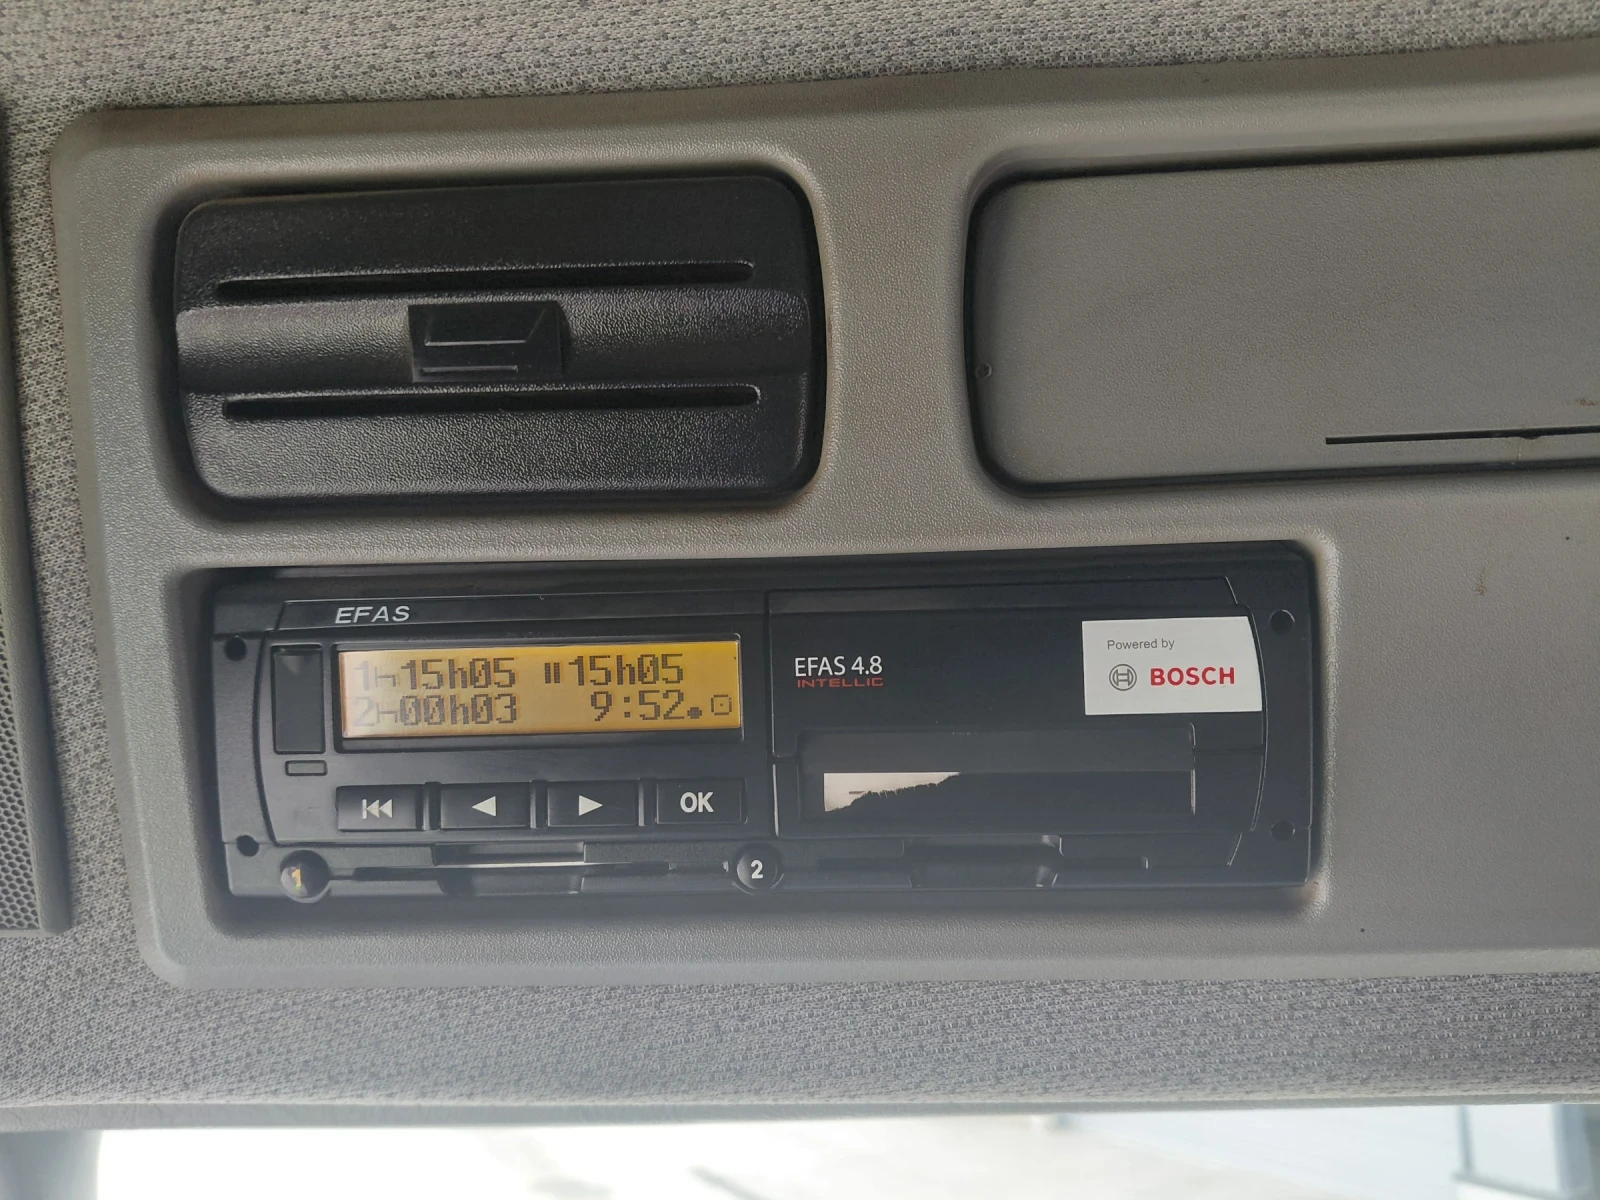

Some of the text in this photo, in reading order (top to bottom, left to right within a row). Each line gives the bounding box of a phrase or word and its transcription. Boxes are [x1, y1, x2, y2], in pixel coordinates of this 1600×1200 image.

[334, 605, 411, 625] EFAS
[1107, 638, 1175, 652] Powered by
[794, 655, 883, 677] EFAS 4.8
[1149, 666, 1236, 686] BOSCH
[797, 677, 884, 688] INTELLIC
[680, 791, 714, 813] OK
[750, 860, 764, 880] 2
